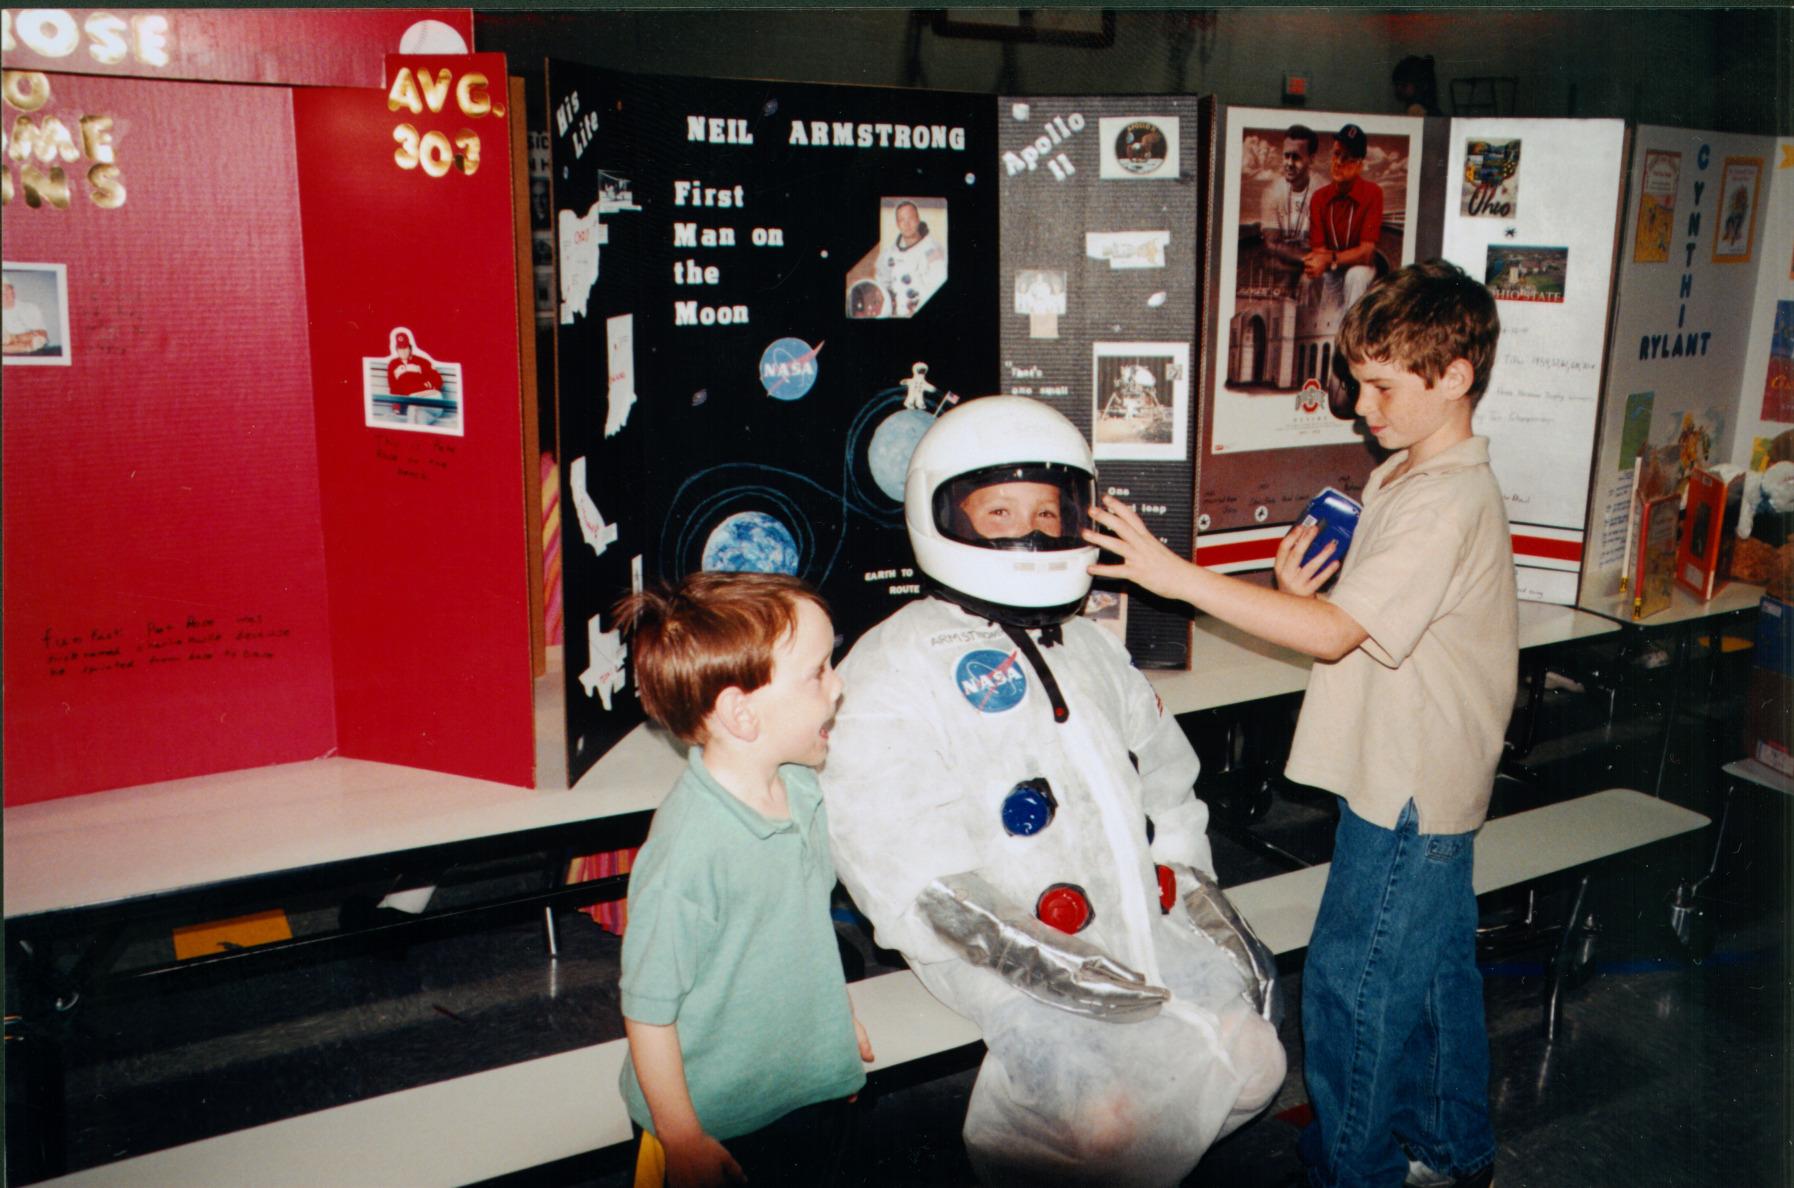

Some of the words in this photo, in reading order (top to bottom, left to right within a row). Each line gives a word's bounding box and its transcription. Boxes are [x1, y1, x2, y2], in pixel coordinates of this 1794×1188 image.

[388, 67, 505, 118] AVG.
[556, 90, 580, 138] His
[686, 116, 754, 145] NEIL
[789, 120, 966, 150] ARMSTRONG
[1003, 112, 1086, 177] Apollo
[393, 123, 481, 177] 303
[674, 180, 744, 207] First
[1468, 187, 1511, 217] Ohio
[673, 223, 736, 247] Man
[751, 227, 784, 246] on
[674, 259, 720, 285] the
[674, 301, 750, 326] Moon
[1639, 332, 1712, 360] RYLANT
[764, 362, 815, 378] NASA
[864, 569, 896, 581] EARTH
[901, 568, 914, 577] TO
[889, 584, 920, 595] ROUTE
[961, 667, 1024, 695] NASA
